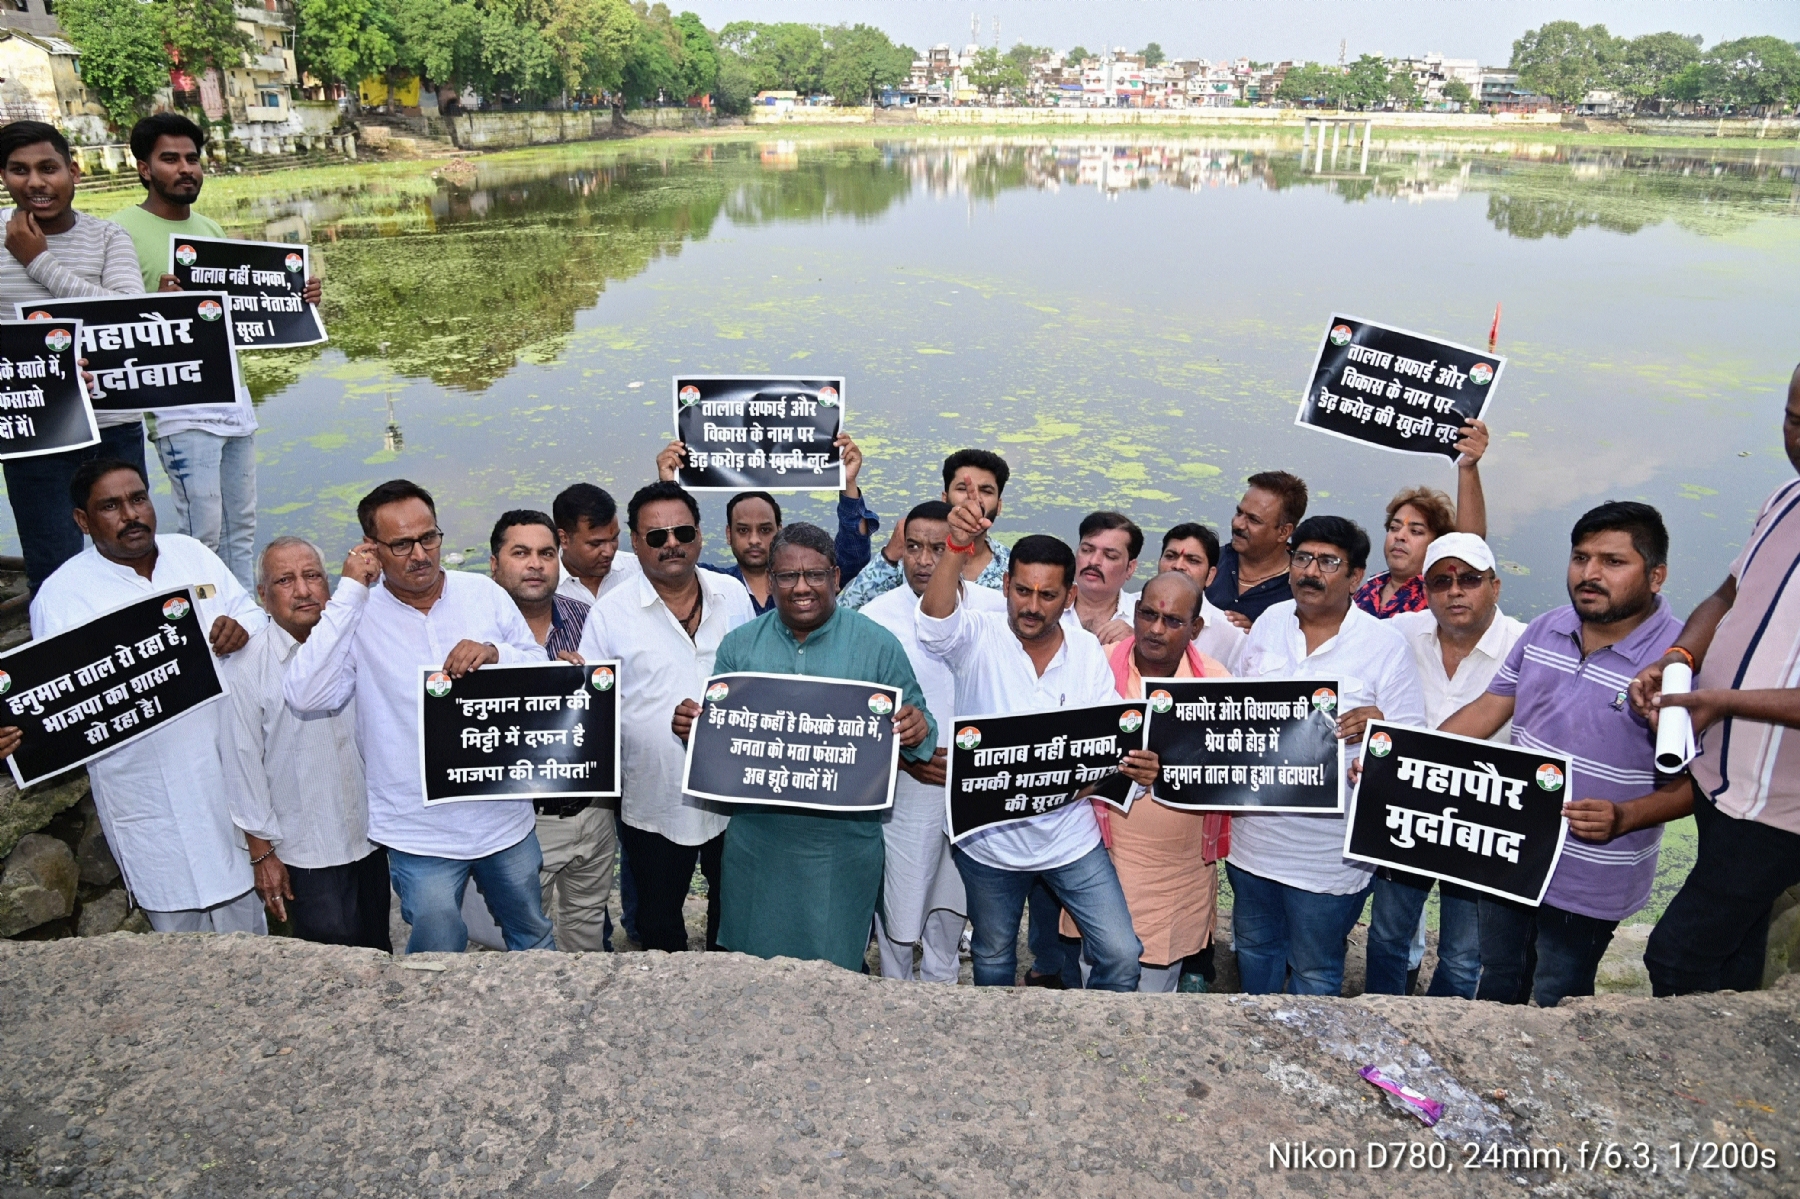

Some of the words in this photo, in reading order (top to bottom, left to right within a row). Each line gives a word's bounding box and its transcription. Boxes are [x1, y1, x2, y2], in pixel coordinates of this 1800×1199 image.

[191, 266, 227, 284] तालाब
[229, 265, 251, 285] नहीं
[252, 270, 291, 290] चमका,
[228, 295, 258, 311] ाजपा
[260, 291, 303, 312] नेताओं
[235, 322, 265, 342] सूरत
[16, 355, 46, 379] खाते
[49, 354, 65, 379] में,
[1347, 344, 1394, 369] तालाब
[1394, 356, 1437, 383] सफाई
[1435, 364, 1468, 390] और
[1341, 366, 1386, 396] विकास
[1386, 378, 1403, 399] के
[1403, 387, 1433, 411] नाम
[1433, 394, 1456, 414] पर
[702, 400, 745, 416] तालाब
[749, 396, 787, 418] सफाई
[791, 396, 817, 416] और
[1339, 396, 1375, 424] करोड़
[1374, 405, 1396, 427] की
[1396, 413, 1435, 438] खुली
[703, 422, 747, 442] विकास
[750, 422, 764, 442] के
[767, 427, 794, 442] नाम
[797, 427, 815, 442] पर
[711, 448, 745, 472] करोड़
[748, 449, 765, 469] की
[769, 449, 803, 474] खुली
[807, 453, 829, 474] लूट
[6, 674, 76, 715] हनुमान
[74, 655, 116, 687] ताल
[115, 644, 135, 668] रो
[135, 633, 165, 659] रहा
[158, 623, 188, 646] है,
[42, 695, 103, 733] भाजपा
[103, 683, 130, 706] का
[130, 658, 181, 694] शासन
[456, 697, 521, 720] "हनुमान
[525, 696, 562, 711] ताल
[566, 689, 591, 711] की
[1175, 696, 1216, 721] महापौर
[1219, 696, 1242, 720] और
[1244, 697, 1291, 720] विधायक
[1293, 696, 1309, 720] की
[84, 721, 110, 745] सो
[110, 710, 140, 733] रहा
[708, 703, 728, 729] डेढ़
[728, 706, 759, 733] करोड़
[787, 711, 798, 733] है
[798, 713, 835, 736] किसके
[838, 715, 865, 737] खाते
[868, 717, 883, 742] में,
[460, 726, 500, 753] मिट्टी
[505, 726, 520, 746] में
[524, 730, 568, 748] दफन
[572, 723, 585, 746] है
[730, 737, 766, 758] जनता
[767, 738, 785, 760] को
[812, 740, 857, 764] फंसाओ
[974, 745, 1030, 767] तालाब
[1034, 735, 1068, 761] नहीं
[1070, 735, 1123, 758] चमका,
[1204, 728, 1225, 752] श्रेय
[1227, 728, 1243, 752] की
[1246, 728, 1266, 757] होड़
[1269, 727, 1281, 752] में
[447, 766, 504, 783] भाजपा
[508, 759, 534, 781] की
[538, 758, 597, 780] नीयत!"
[743, 766, 765, 785] अब
[768, 765, 791, 793] झूठे
[792, 769, 820, 791] वादों
[962, 771, 1012, 793] चमकी
[1015, 769, 1072, 788] भाजपा
[1162, 765, 1202, 790] हनुमान
[1204, 766, 1230, 784] ताल
[1231, 766, 1248, 784] का
[1250, 766, 1275, 791] हुआ
[1278, 760, 1324, 785] बंटाधार!
[1397, 756, 1528, 811] महापौर
[1004, 794, 1028, 812] की
[1032, 792, 1068, 814] सूरत
[1385, 804, 1526, 864] मुर्दाबाद
